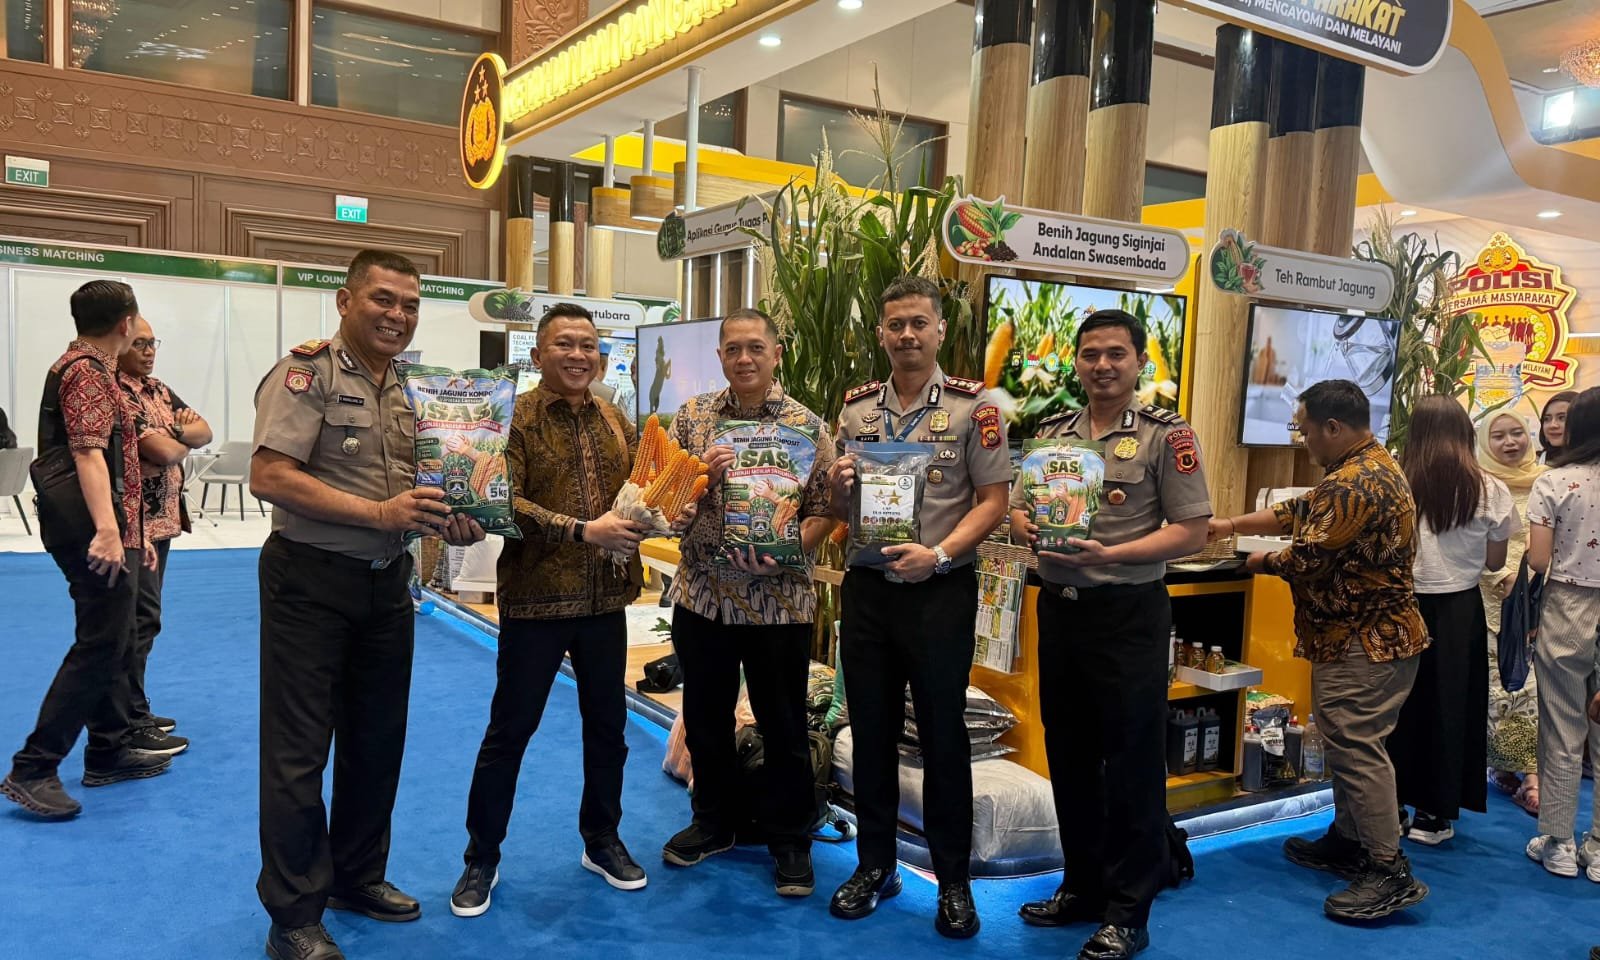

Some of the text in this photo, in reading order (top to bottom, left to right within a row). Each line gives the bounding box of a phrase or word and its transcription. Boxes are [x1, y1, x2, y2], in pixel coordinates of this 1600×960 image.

[1325, 18, 1349, 37] DAN
[1351, 27, 1402, 54] MELAYANI
[15, 170, 39, 183] EXIT
[341, 207, 361, 220] EXIT
[1038, 222, 1166, 254] Benih Jagung Siginjai
[0, 245, 105, 263] INESS MATCHING
[1033, 242, 1167, 271] Andalan Swasembada
[297, 272, 314, 282] VIP
[316, 274, 347, 285] LOUN
[1275, 268, 1376, 298] Teh Rambut Jagung
[1448, 271, 1554, 292] POLISI
[1491, 292, 1557, 305] MASYARAKAT
[590, 309, 630, 321] tubara
[1522, 363, 1551, 375] MELAYANI
[439, 388, 467, 397] JAGUNG
[427, 402, 492, 422] SAS
[740, 449, 789, 470] SAS
[1049, 460, 1078, 473] SAS
